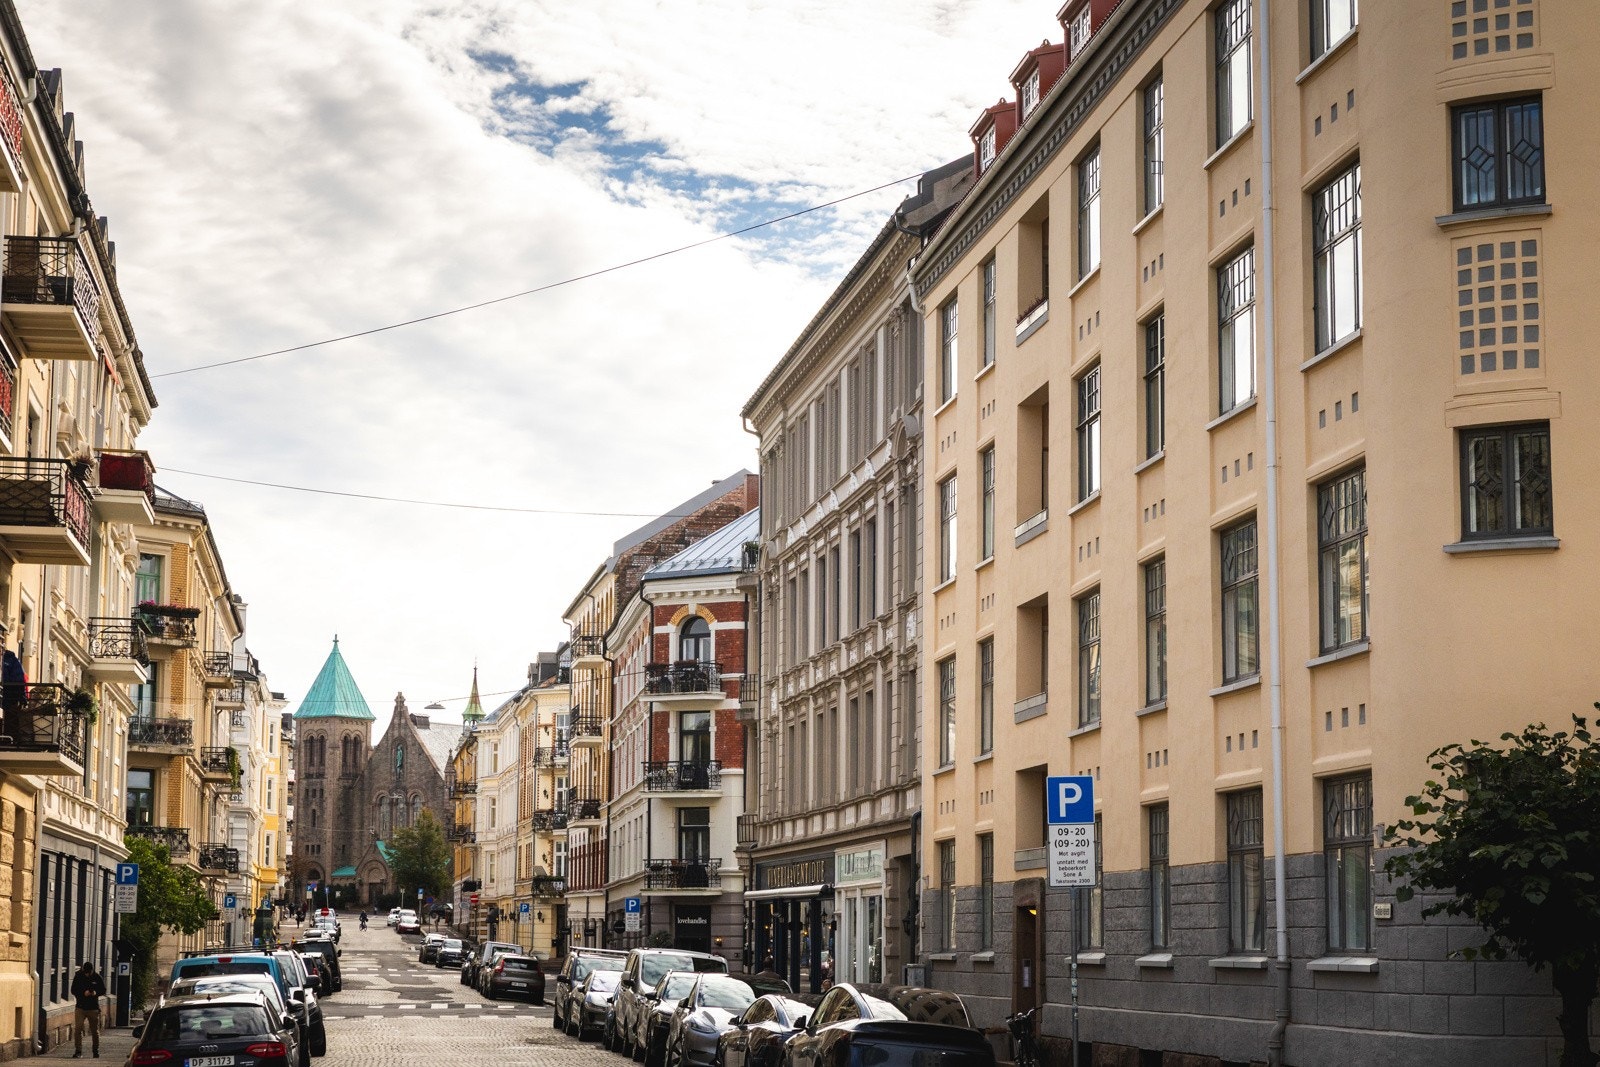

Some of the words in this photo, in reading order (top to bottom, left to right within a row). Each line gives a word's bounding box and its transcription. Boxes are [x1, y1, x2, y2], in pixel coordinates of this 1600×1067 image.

[1059, 783, 1082, 817] P
[1057, 828, 1085, 836] 09-20
[1054, 839, 1090, 848] (09-20)
[122, 866, 133, 882] P
[227, 898, 233, 906] P
[629, 900, 636, 910] P
[121, 965, 128, 973] P
[207, 1057, 232, 1065] 31173
